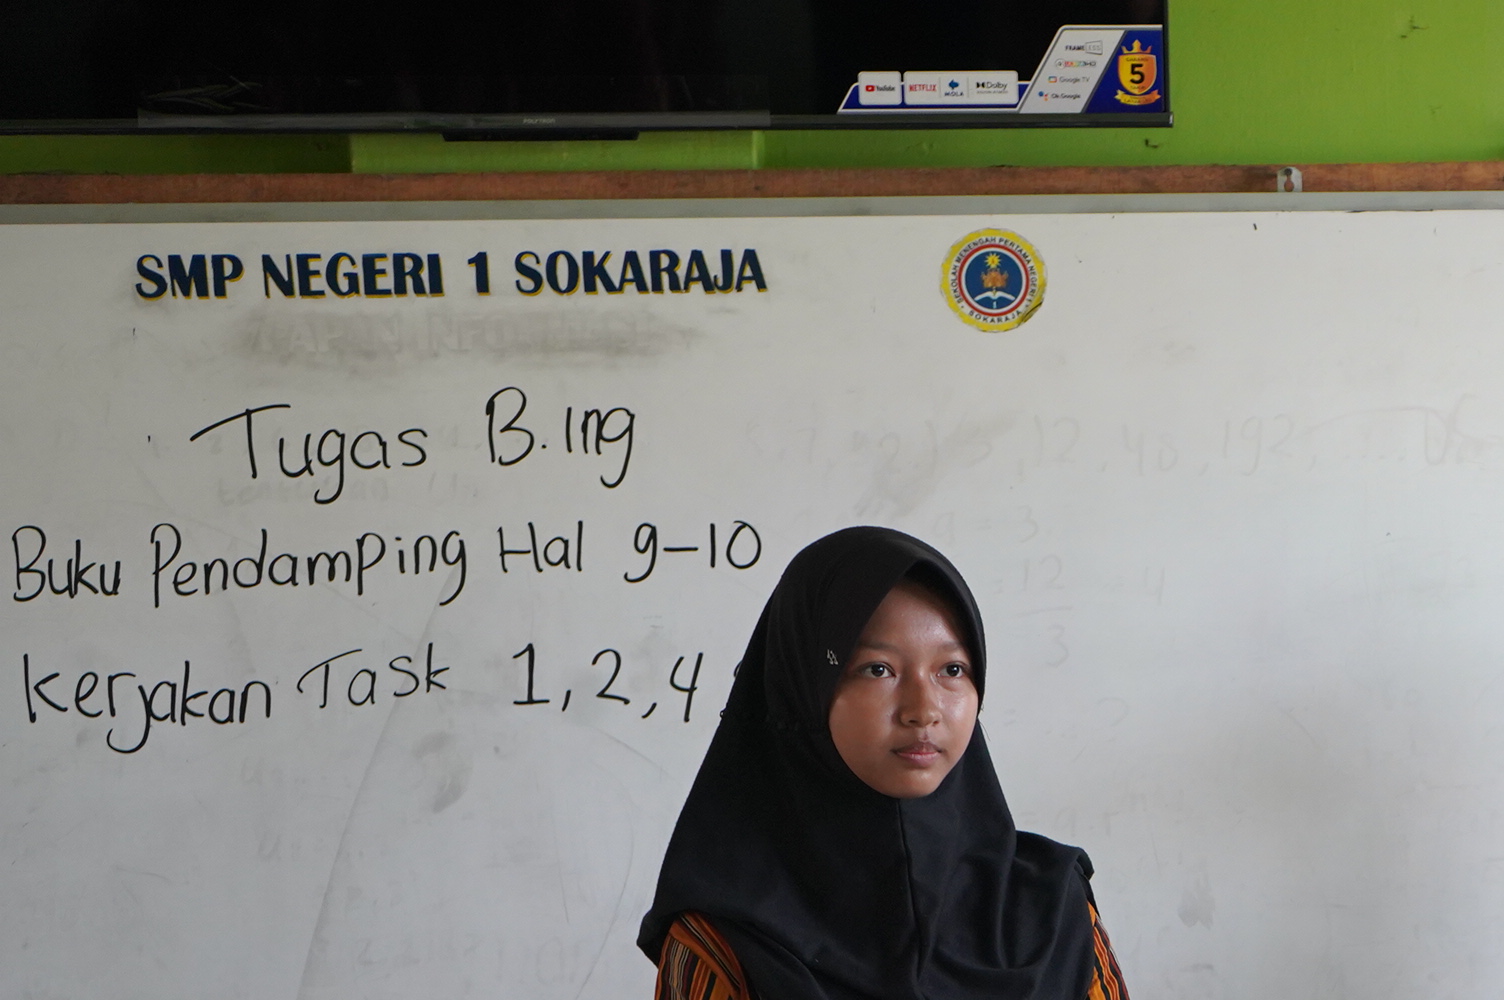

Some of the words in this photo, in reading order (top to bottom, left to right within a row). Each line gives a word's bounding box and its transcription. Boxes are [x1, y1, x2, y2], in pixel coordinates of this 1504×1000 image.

[986, 81, 1008, 90] Dolby
[1130, 63, 1145, 84] 5
[909, 84, 937, 92] NETFLIX
[956, 237, 997, 263] MENENGAH
[998, 237, 1032, 264] PERTAMA
[135, 253, 245, 300] SMP
[262, 251, 445, 299] NEGERI
[467, 251, 492, 296] 1
[514, 248, 768, 297] SOKARAJA
[951, 265, 963, 304] SEKOLAH
[968, 310, 1022, 323] SOKARAJA
[190, 404, 427, 504] Tugas
[12, 525, 121, 602] Buku
[150, 523, 467, 608] Pendamping
[498, 521, 583, 573] Hal
[624, 521, 762, 583] 9-10
[297, 643, 450, 708] Task
